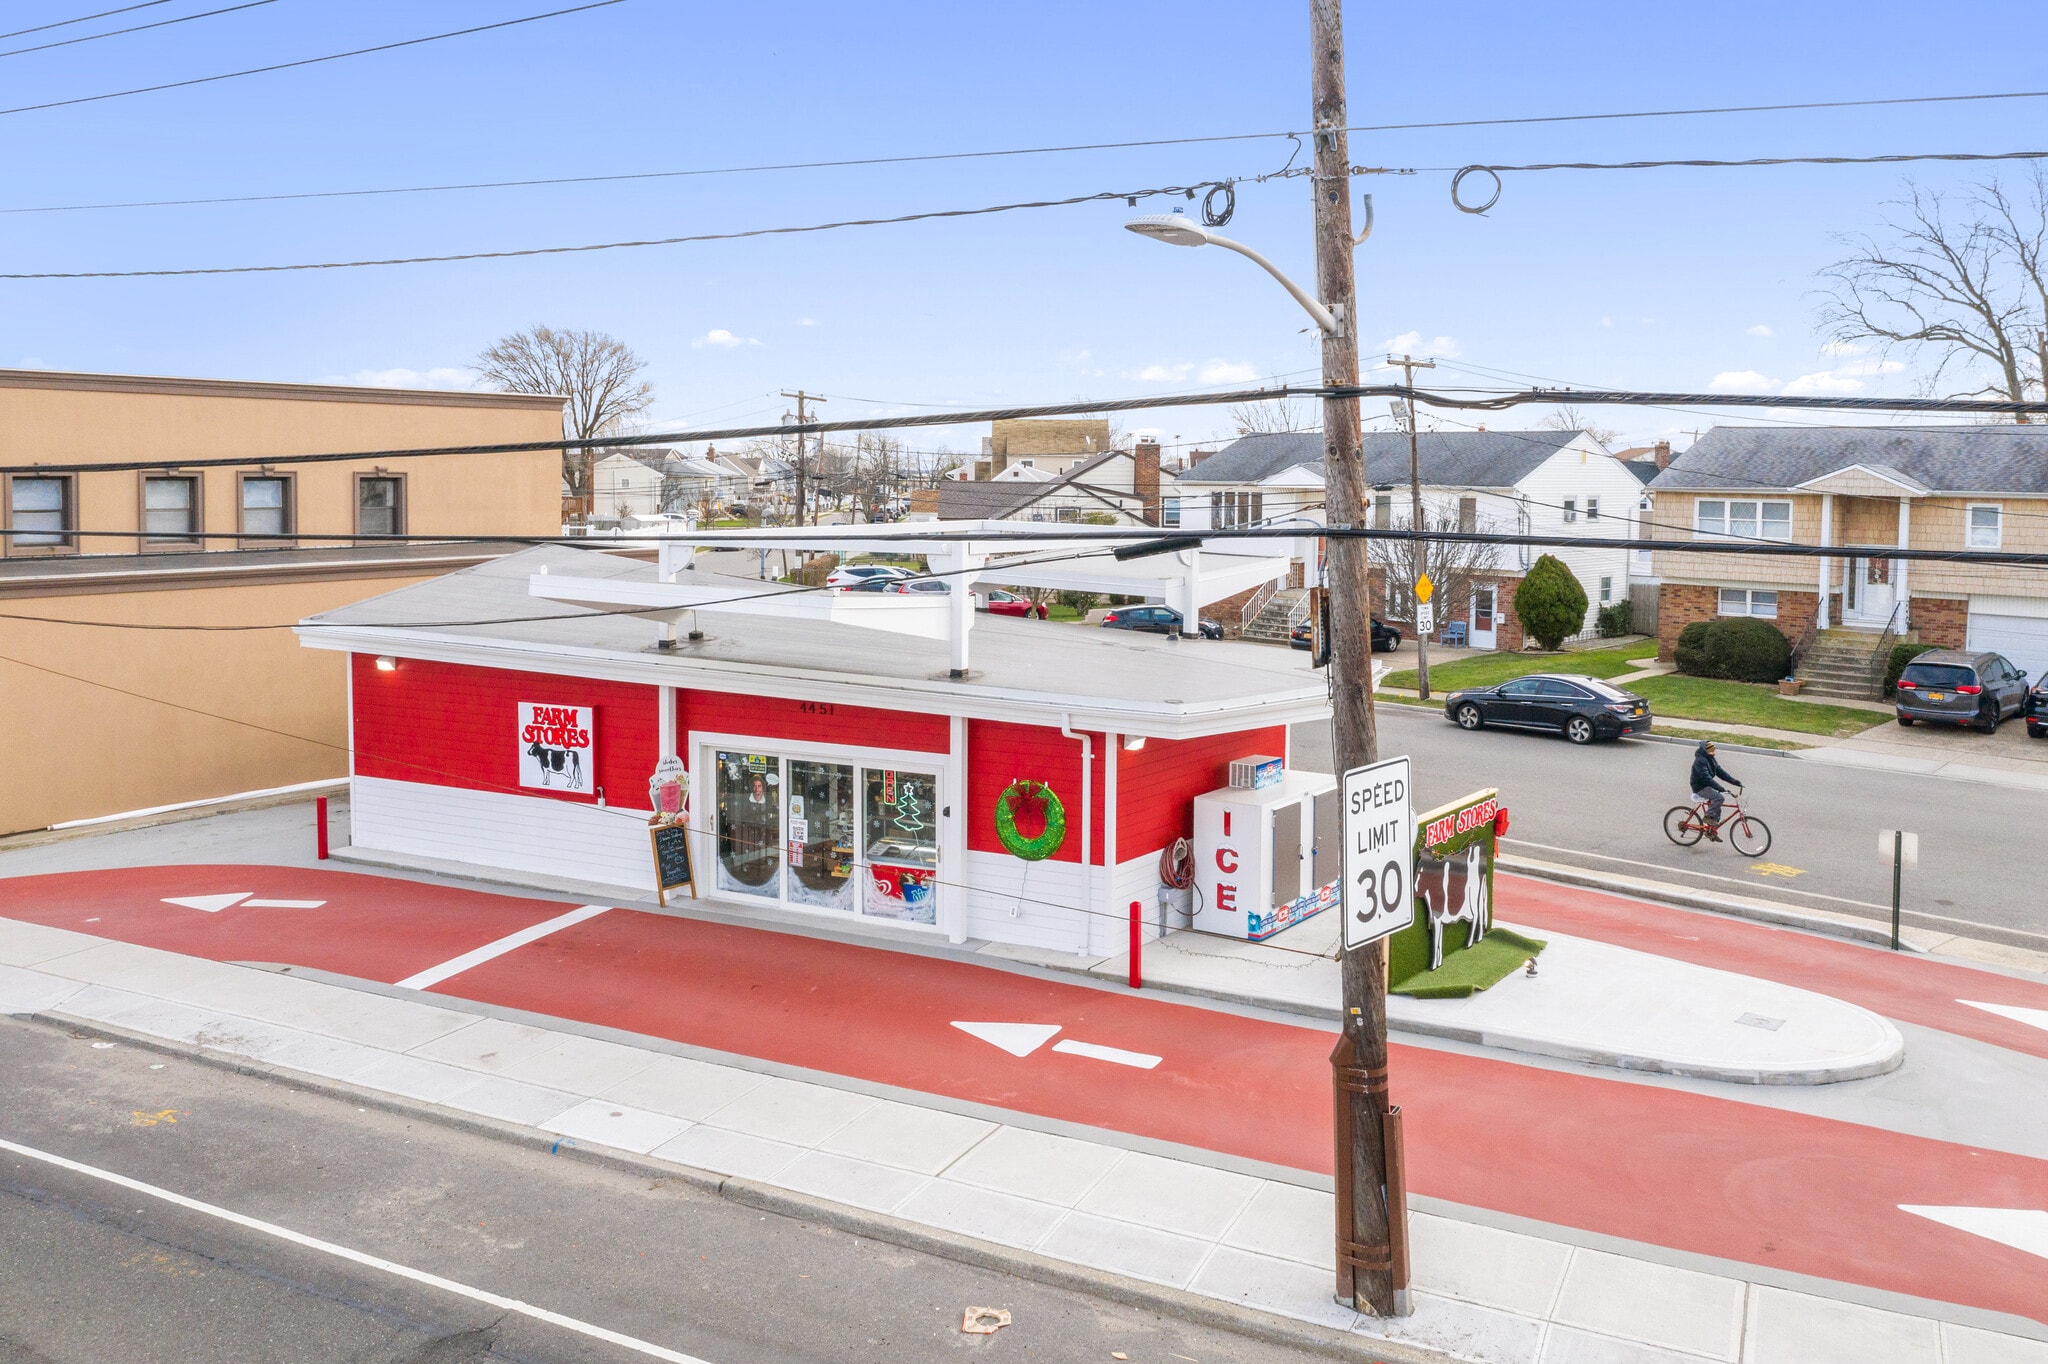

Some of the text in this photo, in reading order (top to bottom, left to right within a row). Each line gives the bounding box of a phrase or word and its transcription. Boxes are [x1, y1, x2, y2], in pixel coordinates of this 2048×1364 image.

[1419, 620, 1432, 632] 30
[532, 706, 578, 728] FARM
[800, 702, 834, 715] 4451
[522, 725, 590, 749] STORES
[885, 769, 895, 803] OPEN
[1351, 779, 1404, 815] SPEED
[1358, 820, 1399, 855] LIMIT
[1425, 798, 1496, 848] FARM STORES
[1216, 807, 1239, 912] ICE
[1356, 860, 1403, 924] 30
[1278, 908, 1289, 921] ICE
